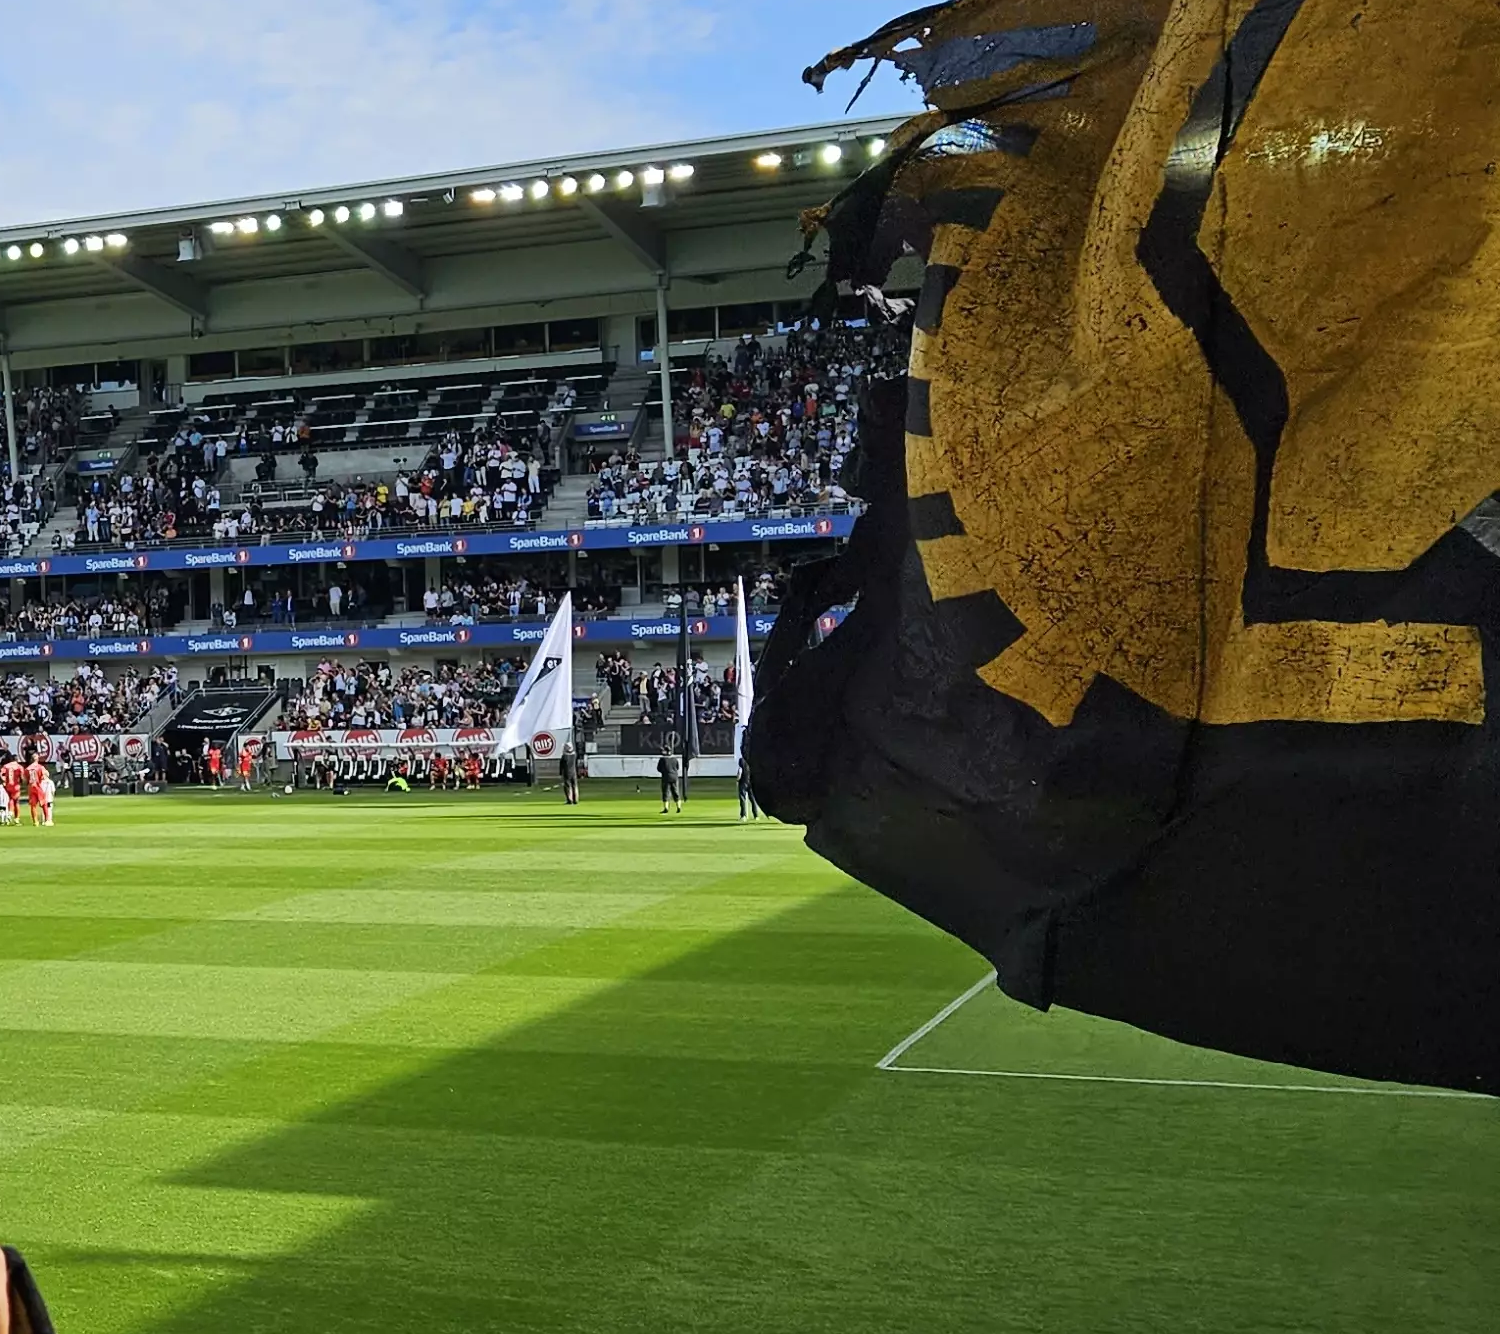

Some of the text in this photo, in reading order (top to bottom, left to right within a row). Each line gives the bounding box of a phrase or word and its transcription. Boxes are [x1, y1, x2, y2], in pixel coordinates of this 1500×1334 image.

[628, 529, 688, 544] SpareBank
[752, 522, 815, 538] SpareBank
[397, 542, 452, 555] SpareBank
[510, 535, 567, 550] SpareBank
[185, 552, 236, 566] SpareBank
[289, 547, 341, 561] SpareBank
[86, 557, 134, 571] SpareBank
[513, 628, 549, 641] Spare
[631, 623, 694, 637] SpareBak
[188, 639, 238, 651] SpareBank
[292, 635, 344, 648] SpareBank
[400, 631, 455, 645] SpareBank
[89, 642, 137, 655] SpareBank
[70, 739, 96, 755] RIIS
[534, 737, 553, 750] RIIS
